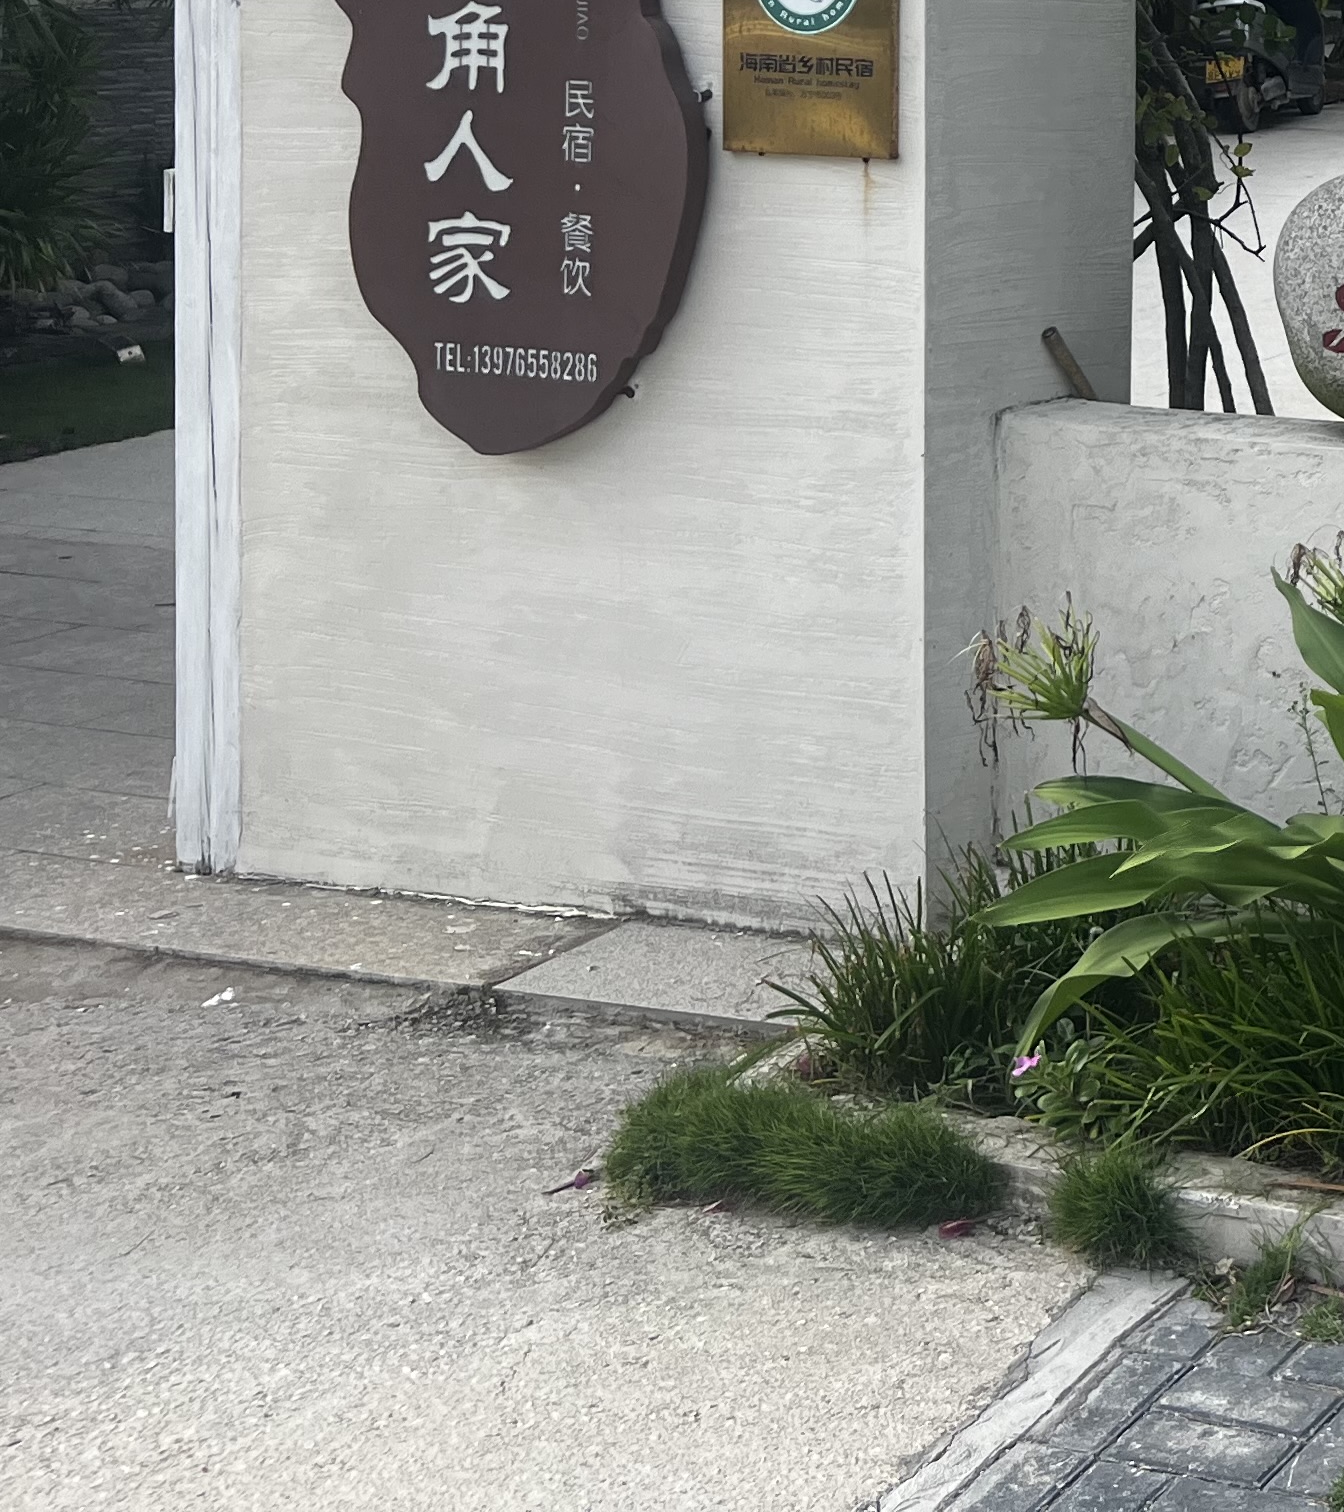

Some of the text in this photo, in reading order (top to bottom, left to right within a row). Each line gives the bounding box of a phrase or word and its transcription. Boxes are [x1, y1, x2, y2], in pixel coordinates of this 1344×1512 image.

[740, 52, 874, 78] 海南省乡村民宿
[434, 342, 598, 382] TEL:13976558286
